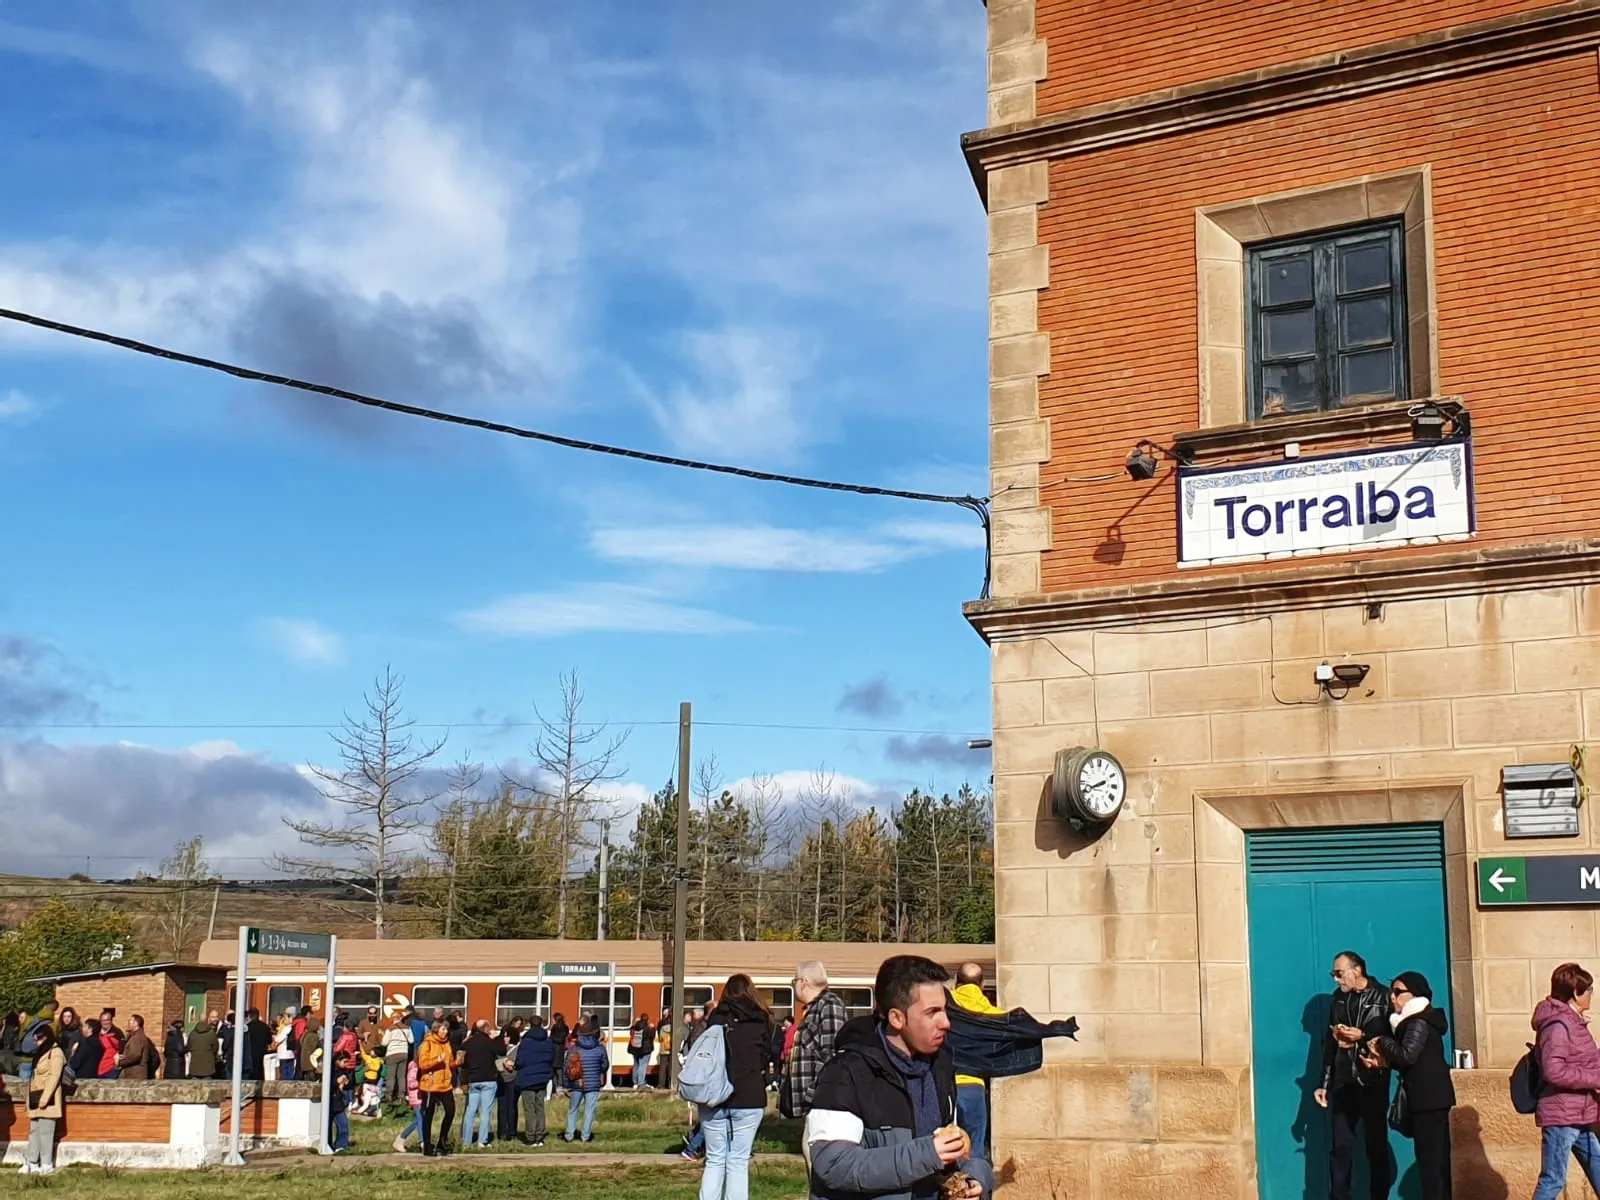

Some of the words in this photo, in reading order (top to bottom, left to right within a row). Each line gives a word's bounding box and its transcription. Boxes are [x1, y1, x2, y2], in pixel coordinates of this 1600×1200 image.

[1213, 480, 1437, 540] Torralba
[1580, 866, 1600, 889] M
[560, 965, 598, 973] TORRALBA
